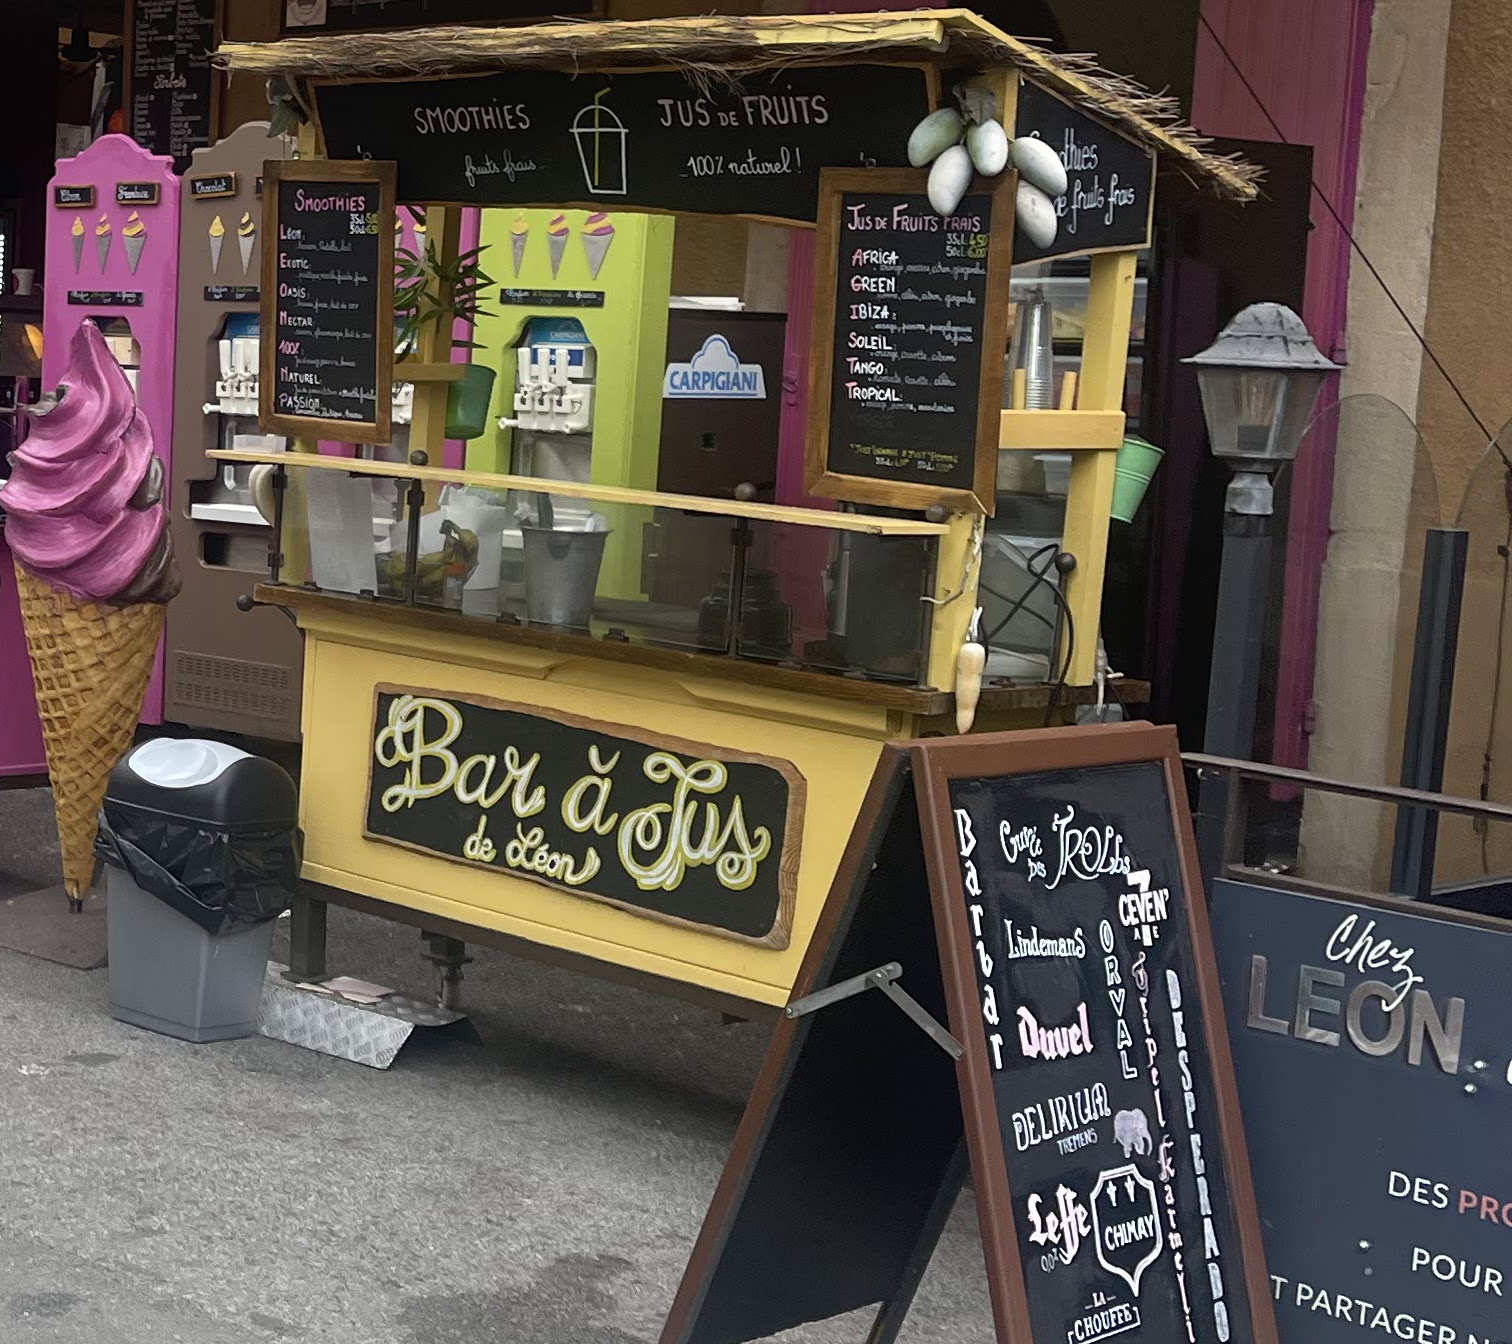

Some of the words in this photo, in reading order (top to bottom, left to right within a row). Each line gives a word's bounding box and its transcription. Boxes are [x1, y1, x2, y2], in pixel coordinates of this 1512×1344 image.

[415, 97, 531, 135] SMOOTHIES
[657, 97, 707, 128] JUS
[717, 110, 739, 127] DE
[744, 94, 829, 126] FRUITS
[465, 153, 500, 188] fruits
[502, 147, 537, 182] frais
[687, 155, 724, 177] 100%
[294, 189, 365, 212] SMOOTHIES
[847, 204, 873, 231] JUS
[892, 203, 938, 232] FRUITS
[1068, 175, 1105, 234] fruits
[1104, 173, 1135, 225] frais
[850, 275, 895, 292] GREEN
[670, 371, 758, 390] CARPIGIANI
[375, 695, 546, 818] Bar
[561, 744, 620, 835] à
[617, 751, 771, 891] Jus
[463, 814, 496, 863] de
[506, 821, 601, 885] Léon
[954, 808, 1003, 1070] Barbar
[1004, 919, 1086, 959] Lindemans
[1325, 913, 1424, 1011] Chez
[1099, 919, 1138, 1079] ORVAL
[1246, 954, 1465, 1074] LEON
[1016, 1002, 1094, 1060] Duvel
[1012, 1082, 1111, 1151] DELIRIUM
[1056, 1127, 1098, 1156] TREMENS
[1388, 1170, 1448, 1209] DES
[1028, 1183, 1091, 1265] Leffe
[1105, 1214, 1154, 1250] CHIMAY
[1412, 1247, 1502, 1296] POUR
[1073, 1304, 1132, 1341] CHOUFFE
